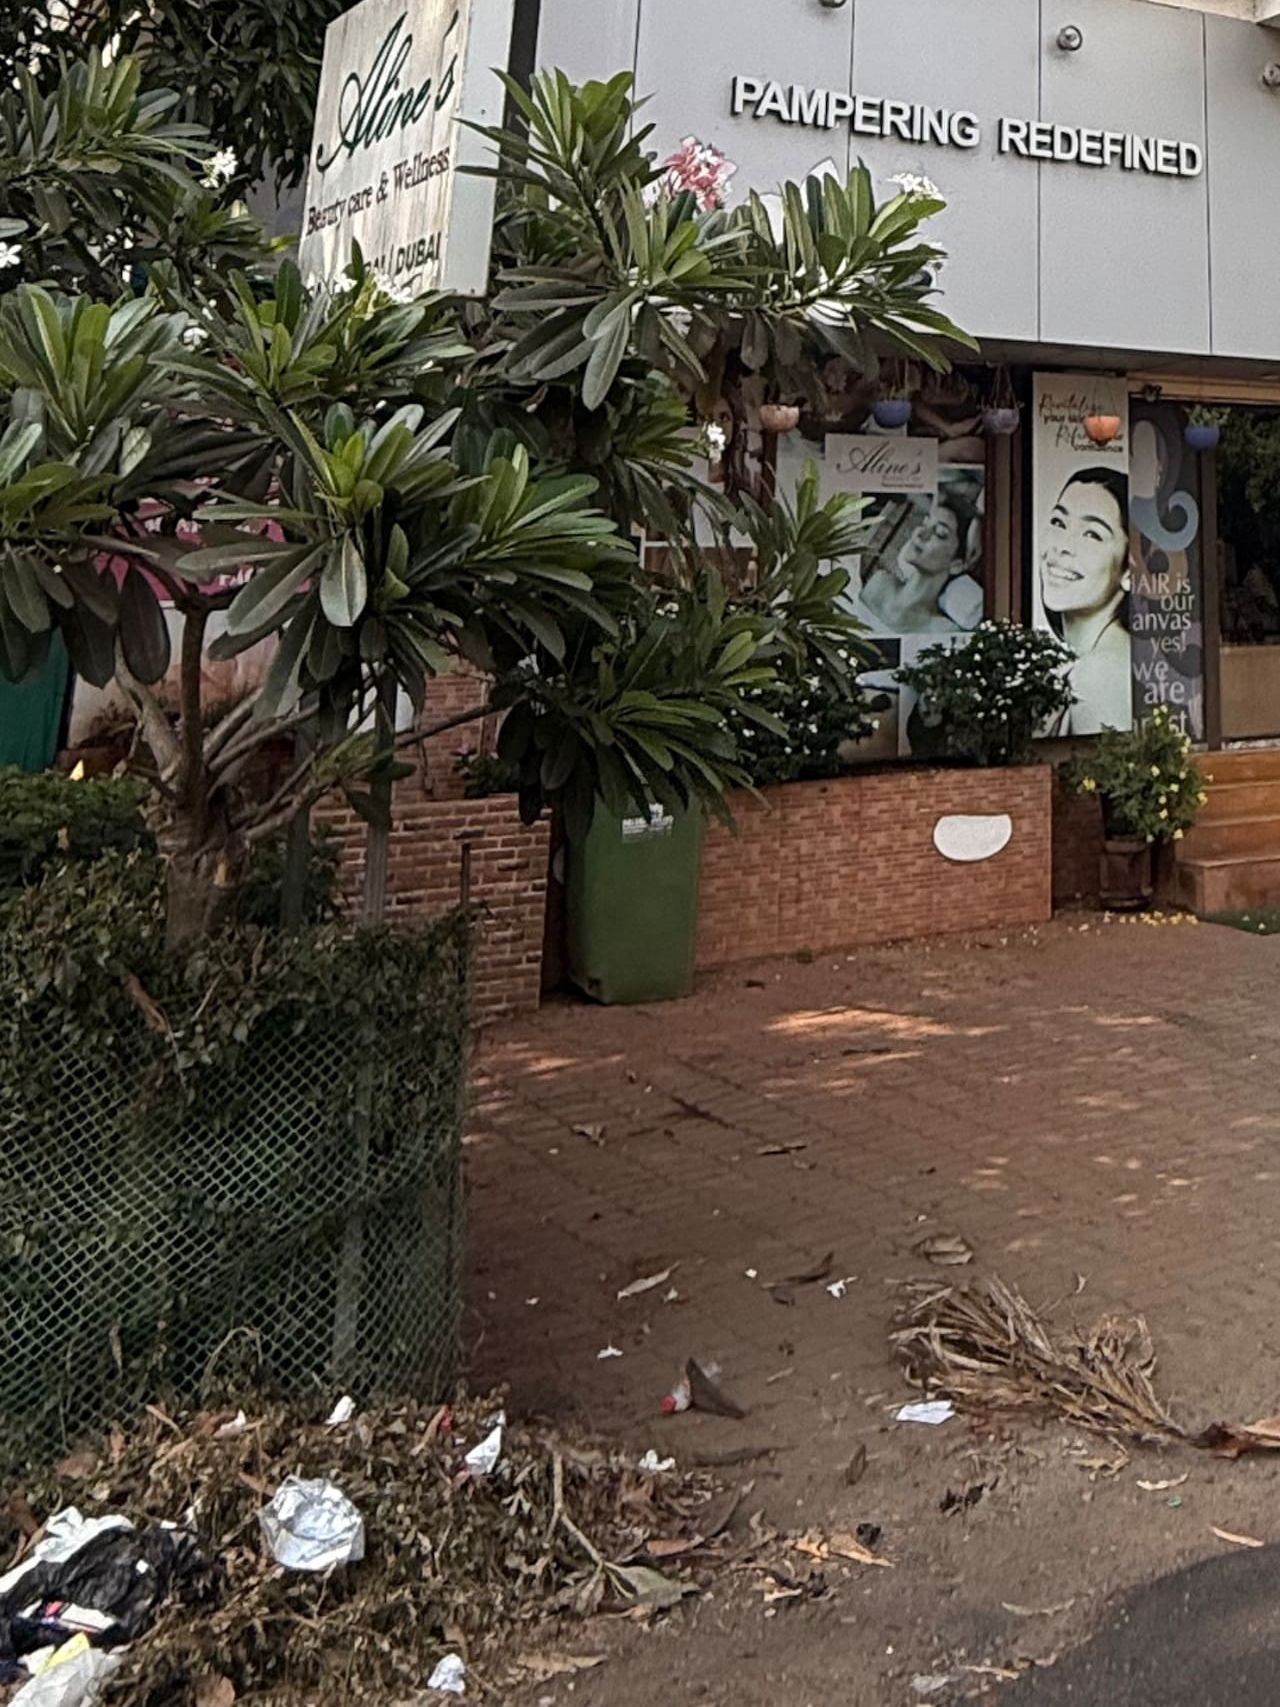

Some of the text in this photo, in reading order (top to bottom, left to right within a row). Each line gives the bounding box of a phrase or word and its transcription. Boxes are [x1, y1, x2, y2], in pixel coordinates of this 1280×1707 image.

[315, 9, 460, 174] Aline's
[731, 75, 1203, 177] PAMPERING REDEFINED
[306, 146, 451, 236] Beauty care & Wellness
[395, 231, 442, 275] DUBAI
[836, 439, 923, 475] Aline's
[1176, 574, 1191, 594] is
[1161, 595, 1195, 612] our
[1132, 612, 1192, 631] anvas
[1151, 629, 1187, 656] yes!
[1133, 660, 1170, 681] we
[1143, 680, 1186, 705] are
